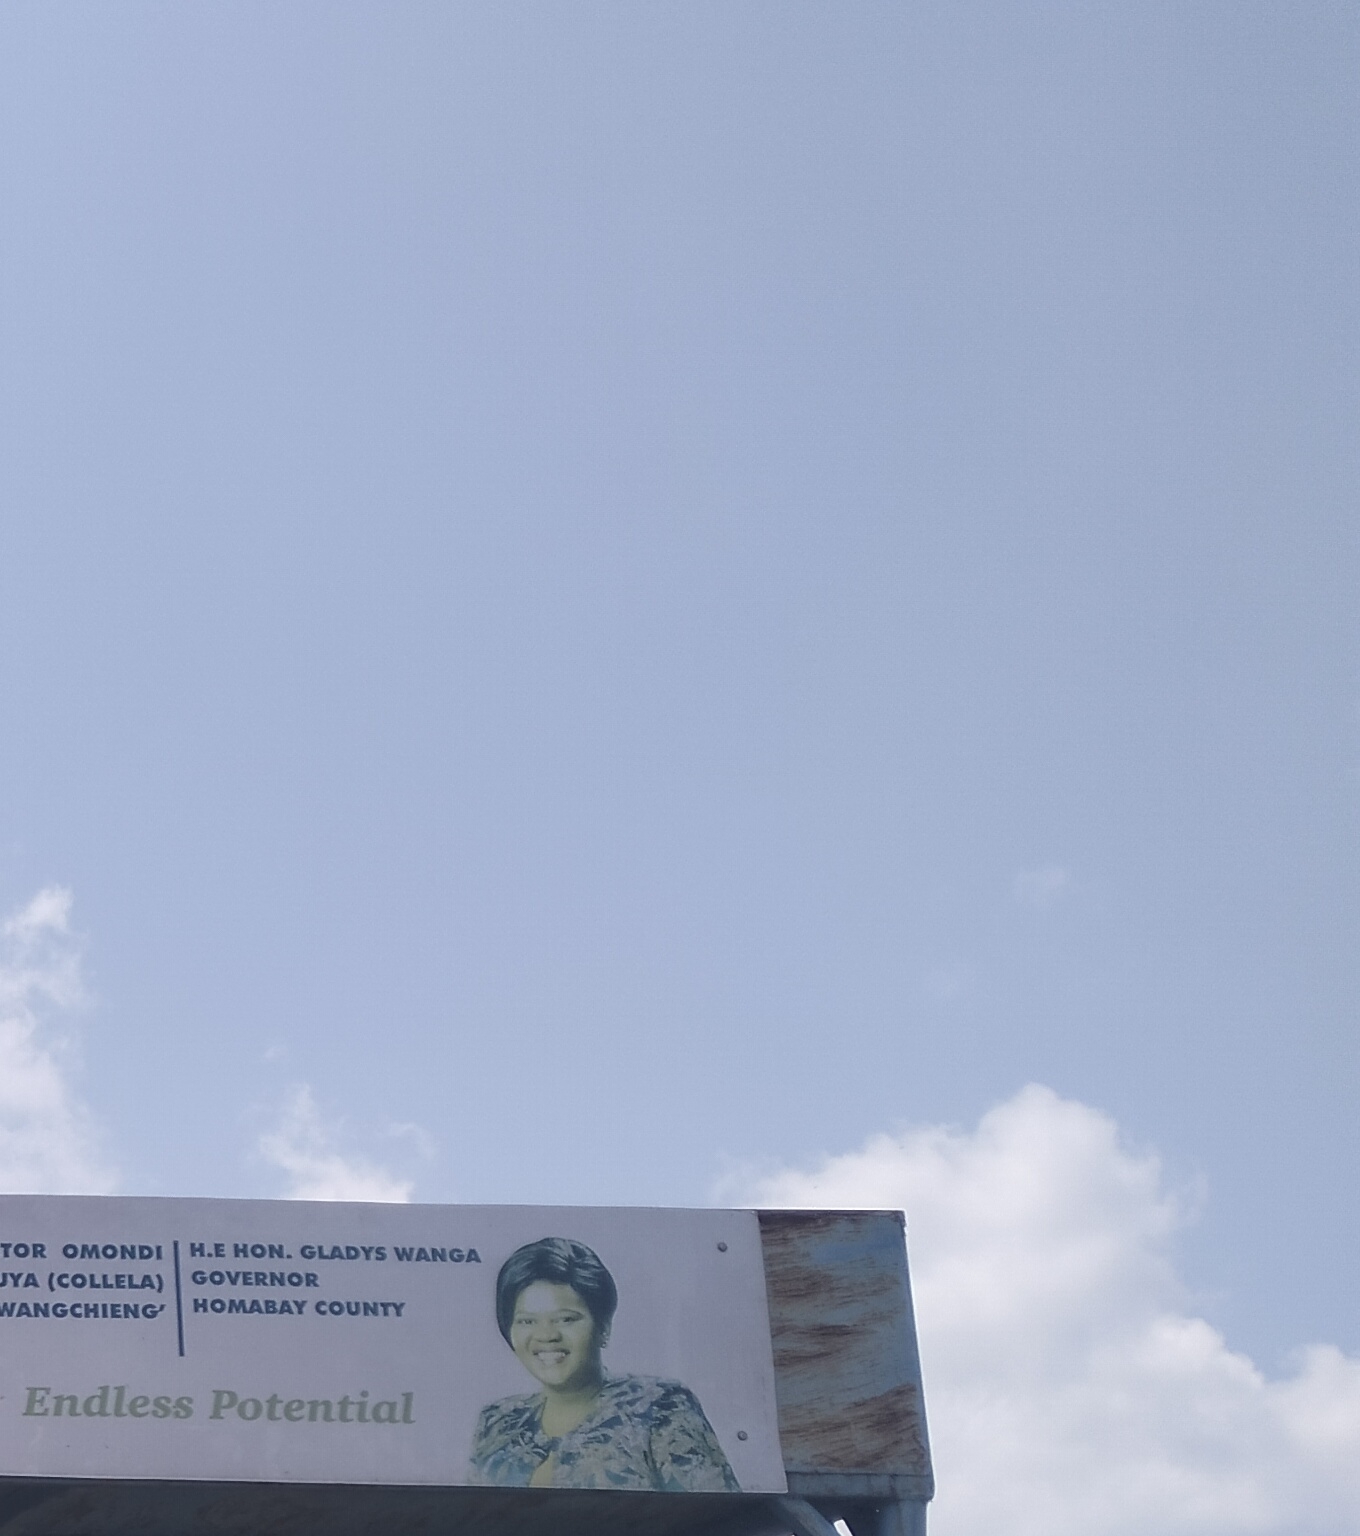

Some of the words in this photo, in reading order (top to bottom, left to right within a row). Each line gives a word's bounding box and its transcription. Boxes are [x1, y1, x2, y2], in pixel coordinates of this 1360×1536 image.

[62, 1244, 162, 1260] OMONDI
[190, 1243, 225, 1257] H.E
[234, 1244, 293, 1259] HON.
[300, 1245, 386, 1261] GLADYS
[394, 1247, 481, 1263] WANGA
[48, 1272, 163, 1293] (COLLELA)
[191, 1271, 319, 1287] GOVERNOR
[193, 1298, 307, 1315] HOMABAY
[315, 1301, 405, 1317] COUNTY
[22, 1385, 193, 1419] Endless
[209, 1390, 415, 1424] Potential
